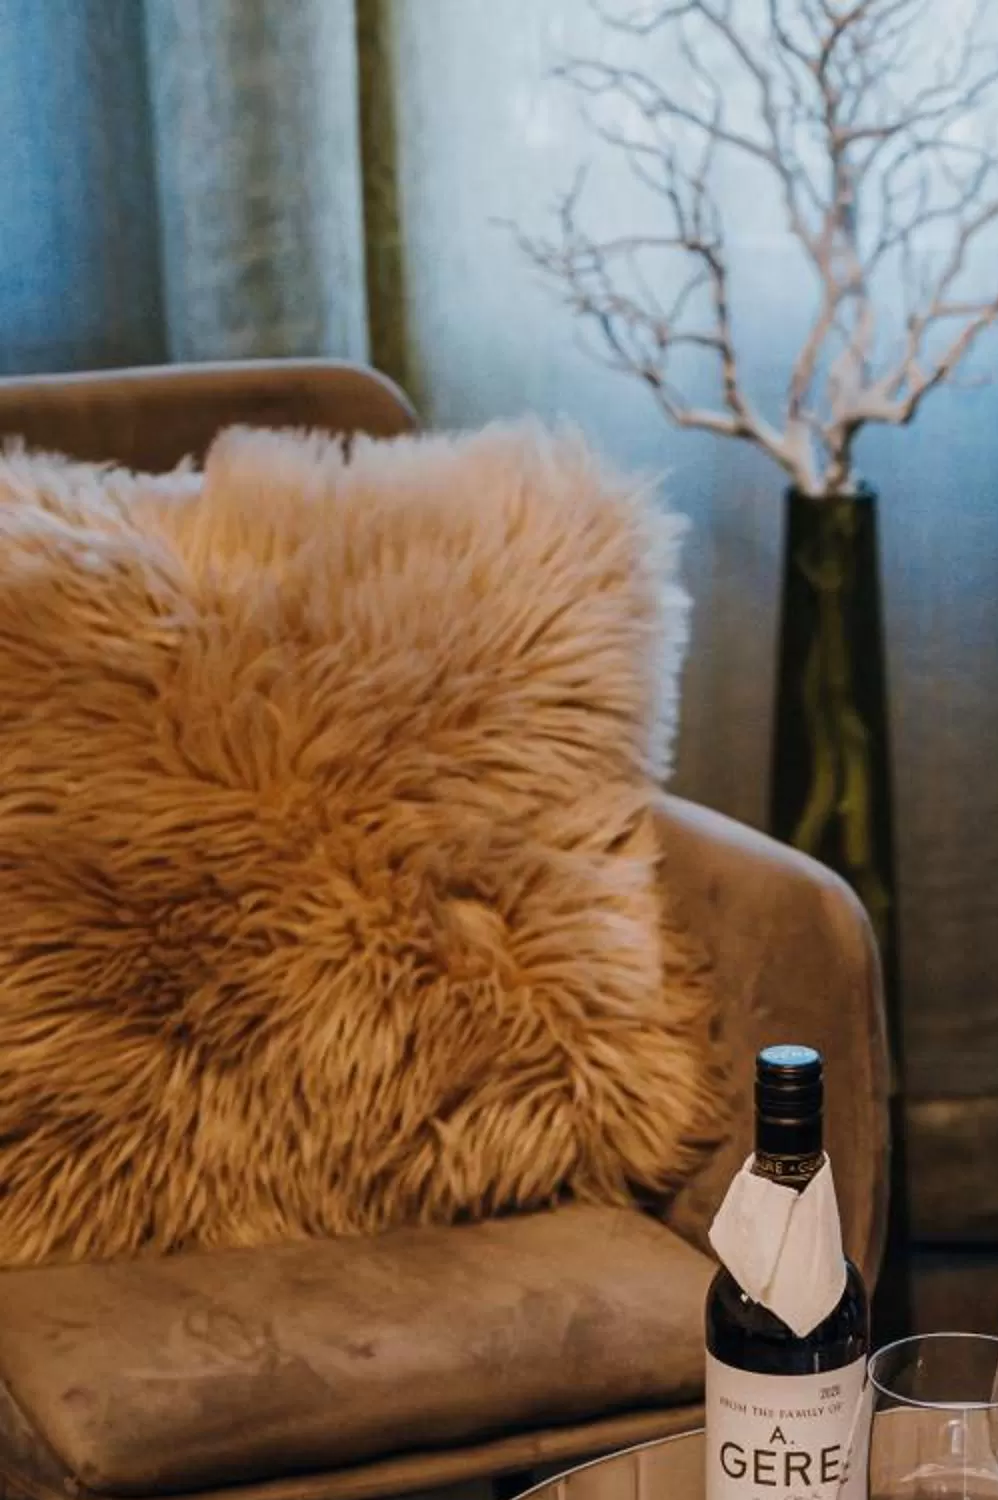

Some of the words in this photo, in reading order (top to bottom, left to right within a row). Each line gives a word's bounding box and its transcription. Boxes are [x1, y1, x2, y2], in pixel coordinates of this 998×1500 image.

[719, 1396, 747, 1415] FROM
[751, 1406, 774, 1418] THE
[779, 1407, 825, 1419] FAMILY
[769, 1426, 795, 1445] A.
[719, 1441, 841, 1487] GERE
